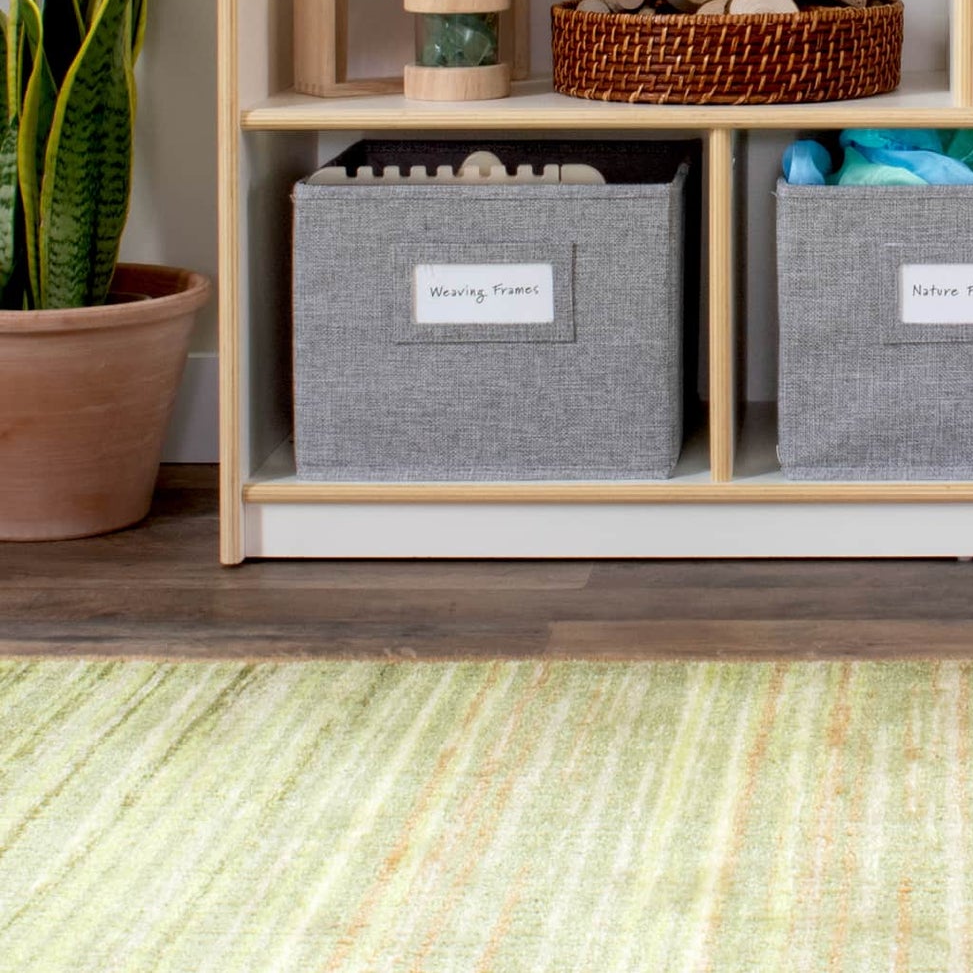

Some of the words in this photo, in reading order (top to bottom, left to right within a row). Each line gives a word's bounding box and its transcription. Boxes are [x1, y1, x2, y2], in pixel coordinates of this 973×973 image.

[430, 285, 487, 304] Weaving
[492, 283, 540, 296] Frames
[912, 284, 959, 297] Nature
